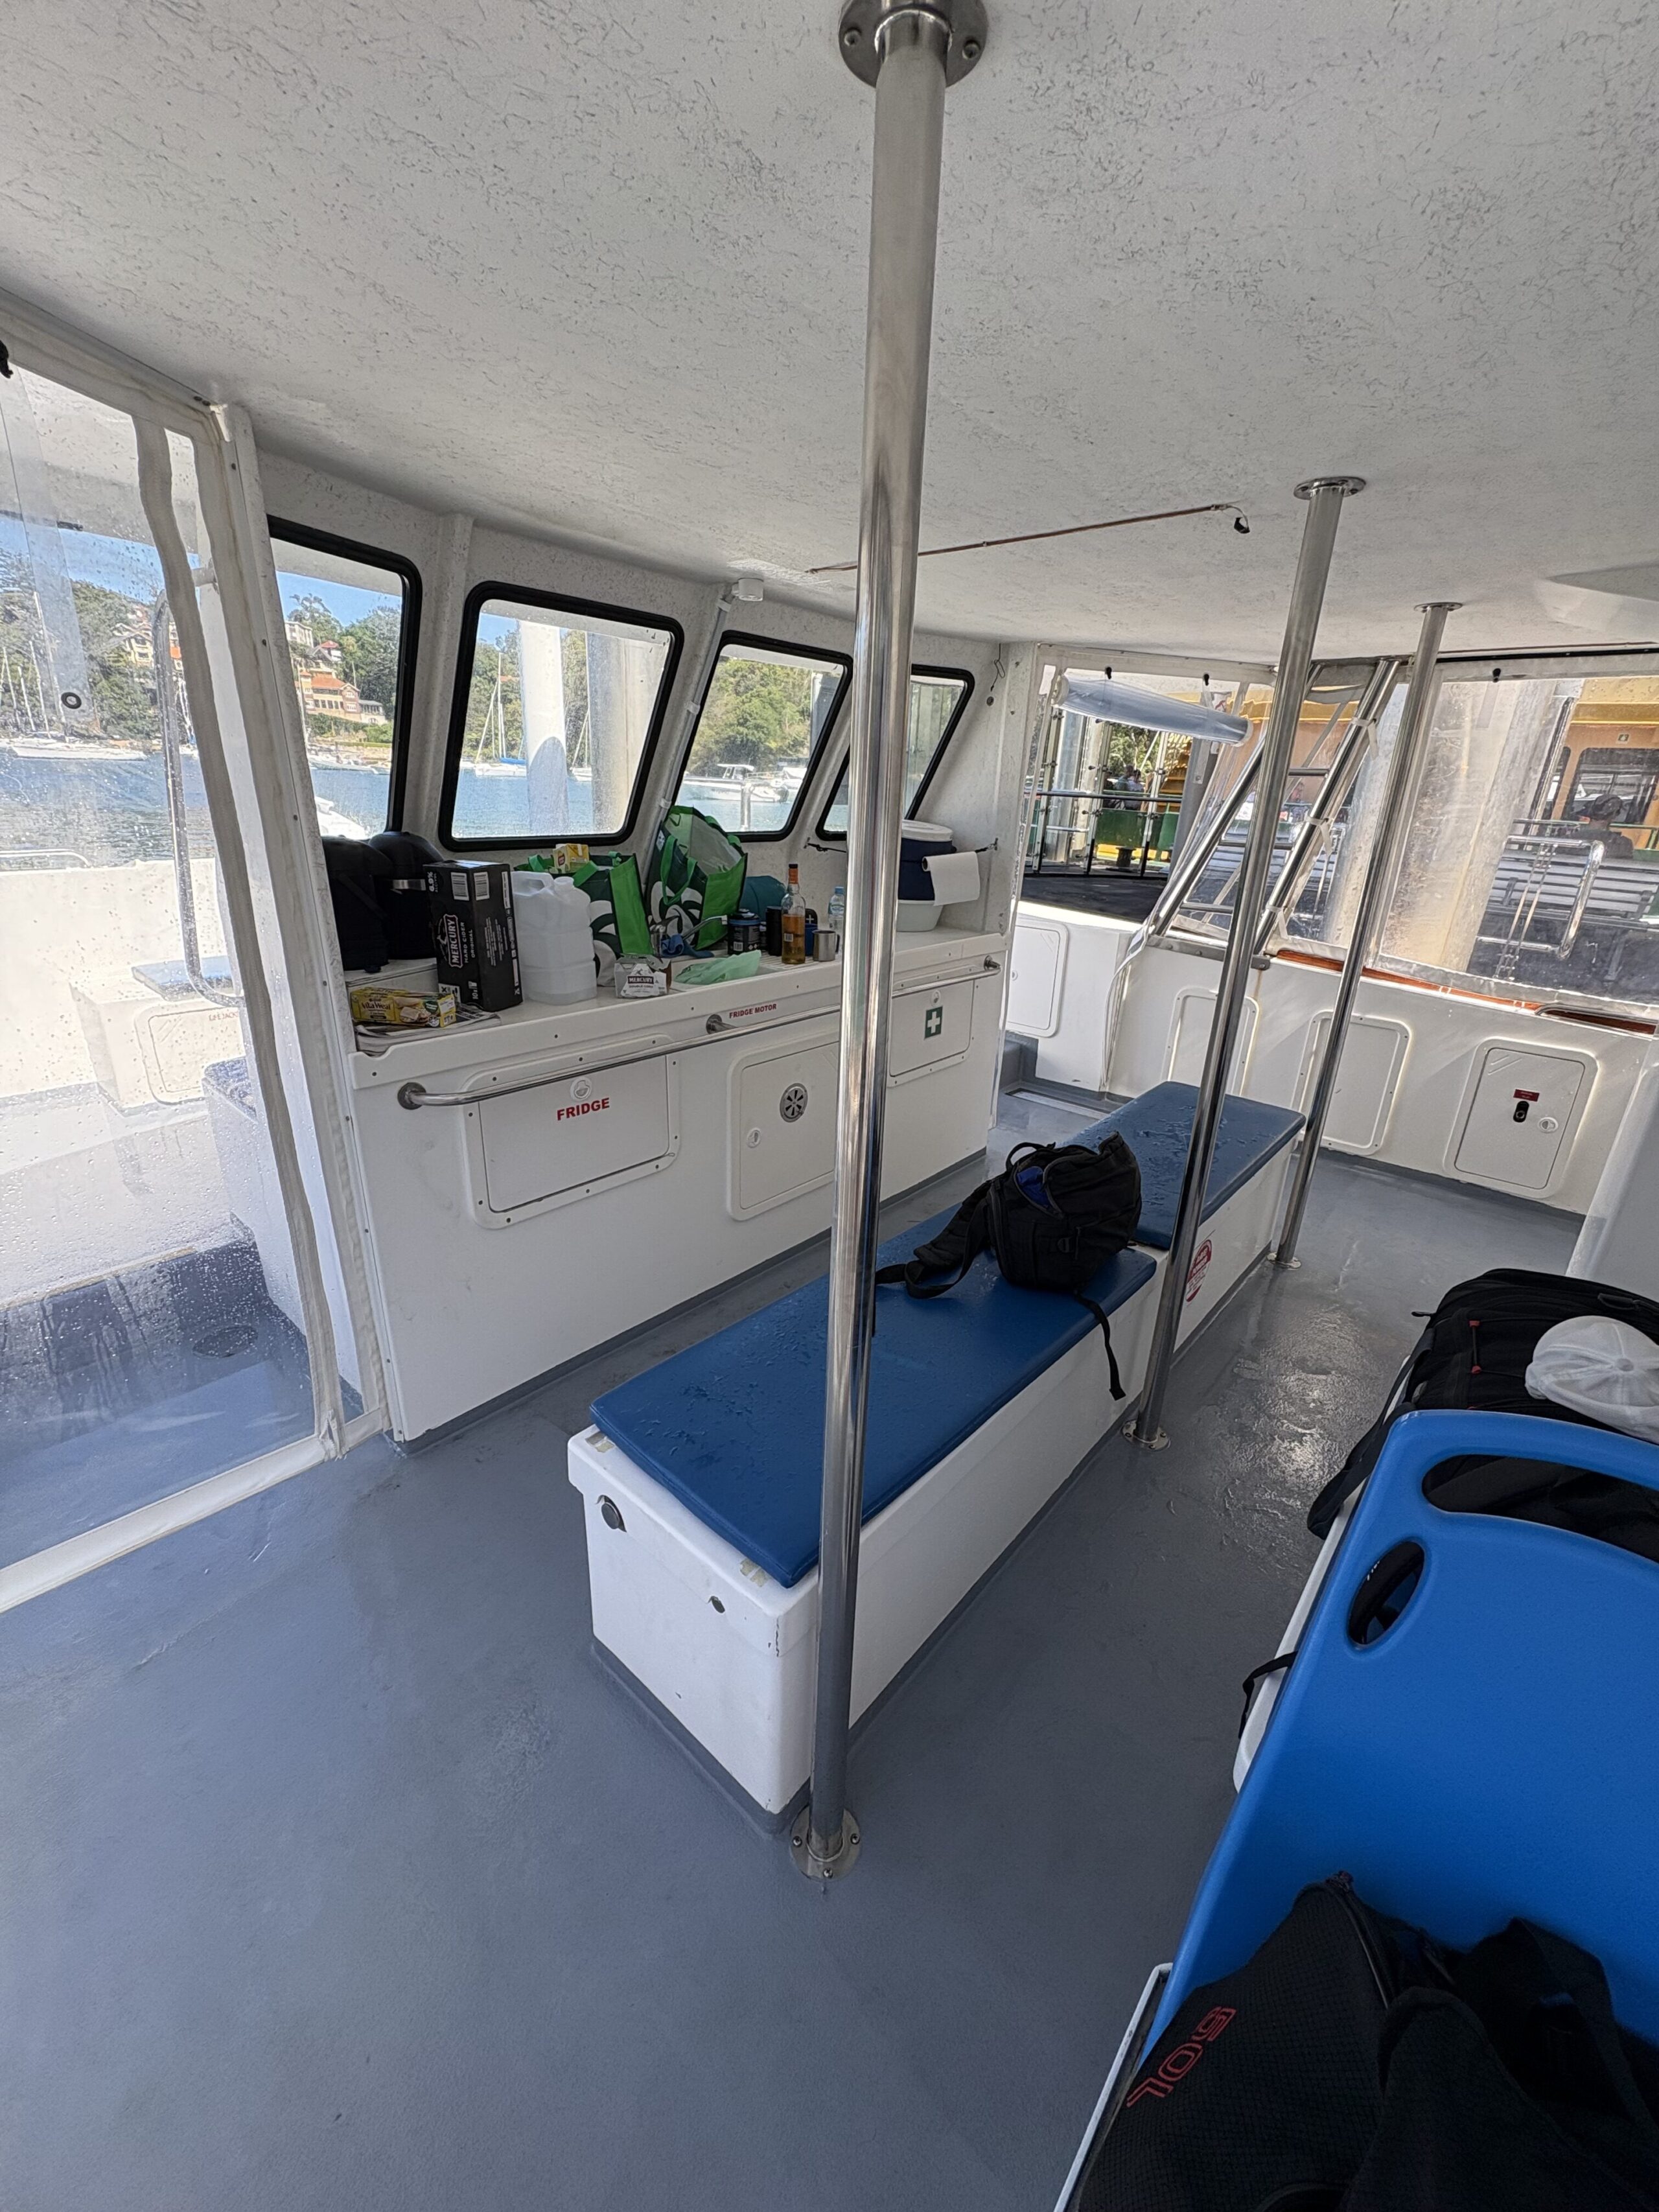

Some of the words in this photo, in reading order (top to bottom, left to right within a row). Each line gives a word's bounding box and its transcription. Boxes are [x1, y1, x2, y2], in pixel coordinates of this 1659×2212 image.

[447, 918, 459, 964] MERCURY
[467, 929, 476, 959] ORIGINAL
[729, 1008, 754, 1019] FRIDGE
[754, 1003, 777, 1014] MOTOR
[557, 1097, 610, 1121] FRIDGE
